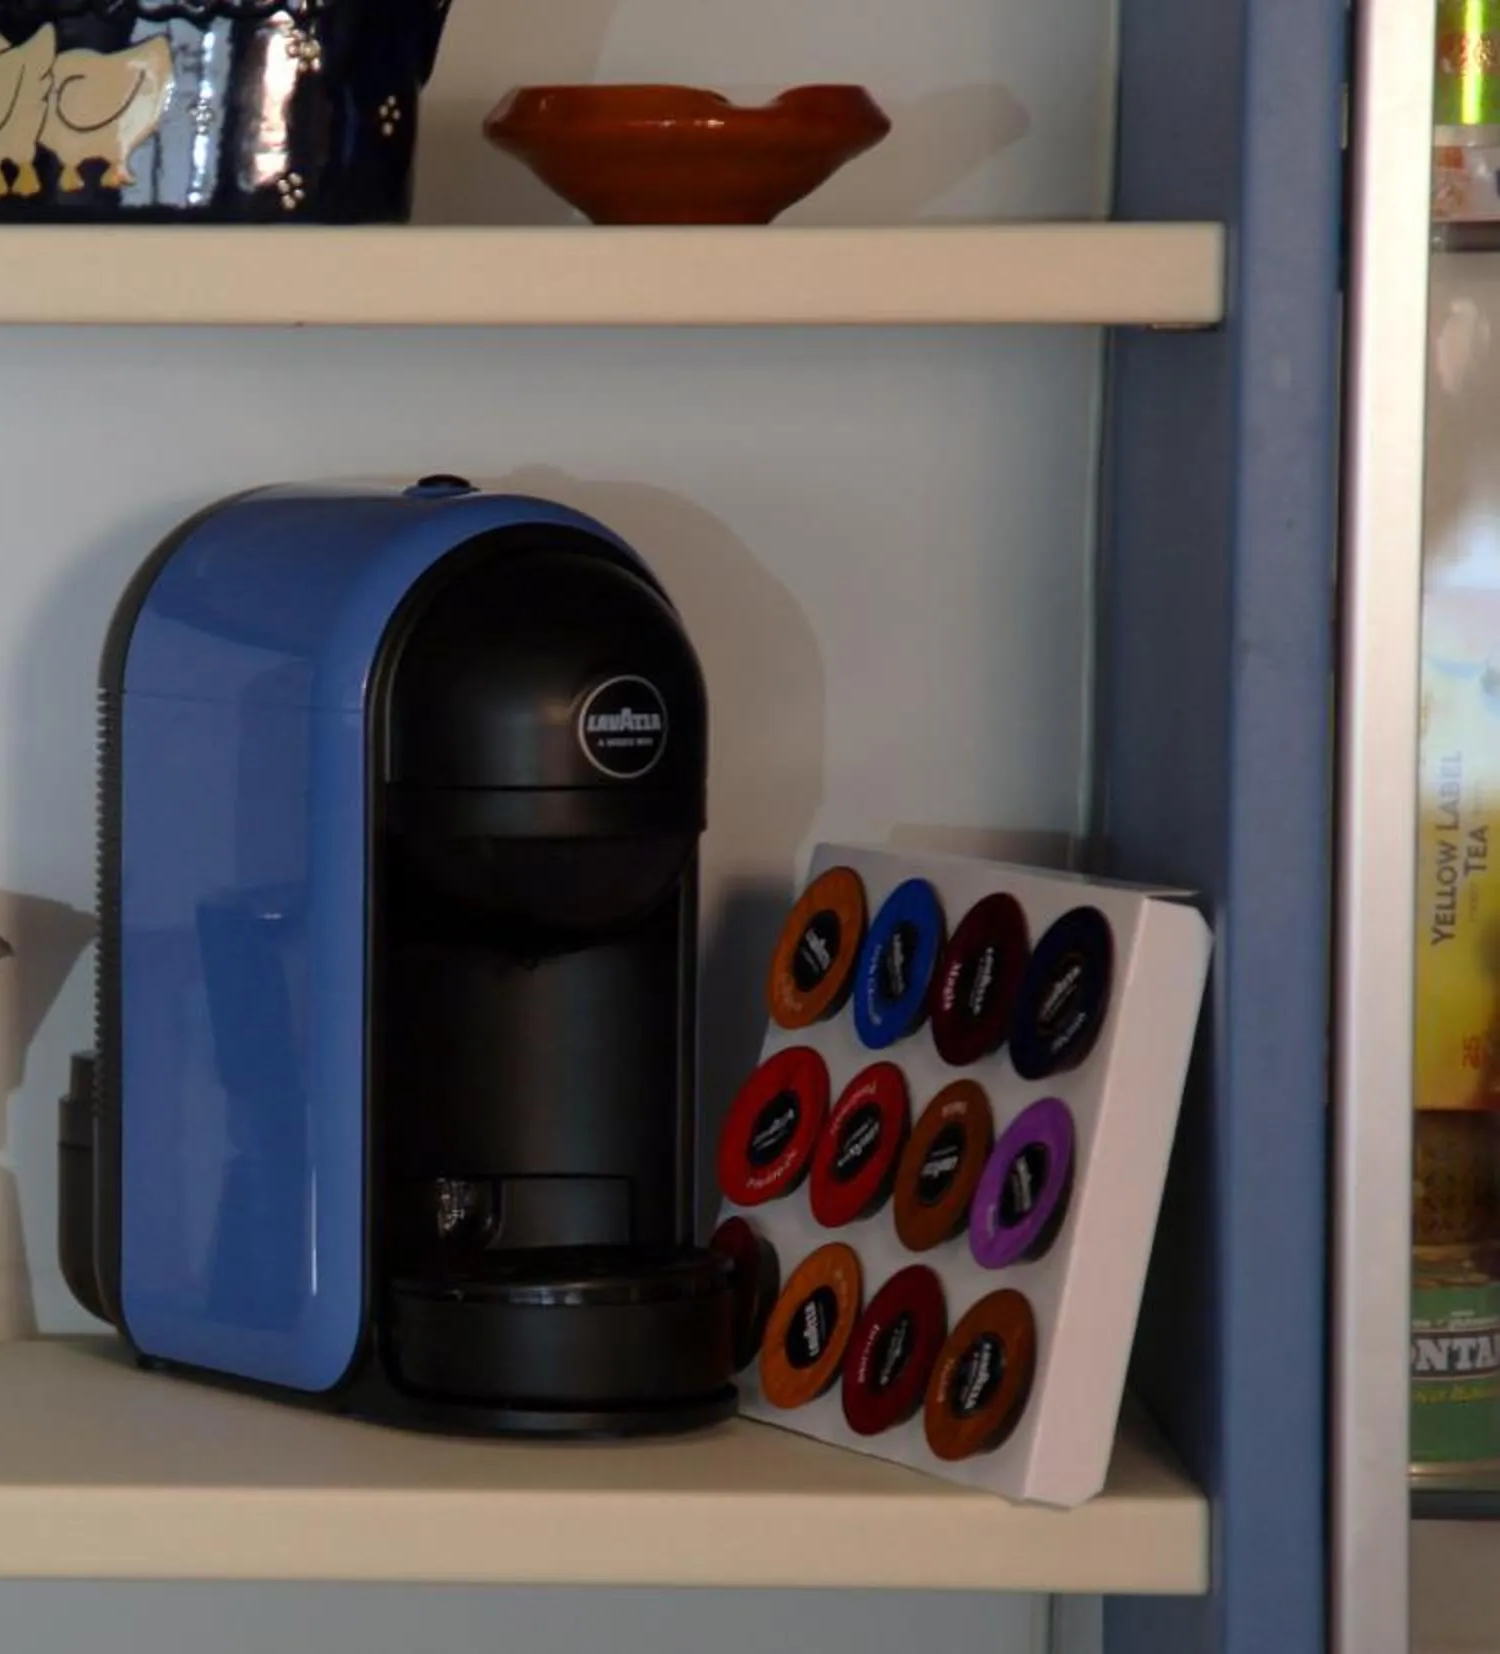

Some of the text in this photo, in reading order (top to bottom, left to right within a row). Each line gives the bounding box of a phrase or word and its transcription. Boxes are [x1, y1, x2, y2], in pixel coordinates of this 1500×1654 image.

[587, 707, 661, 732] LAVAZZA
[1430, 750, 1463, 947] YELLOW LABEL
[1463, 823, 1488, 880] TEA
[1411, 1333, 1500, 1371] NTA
